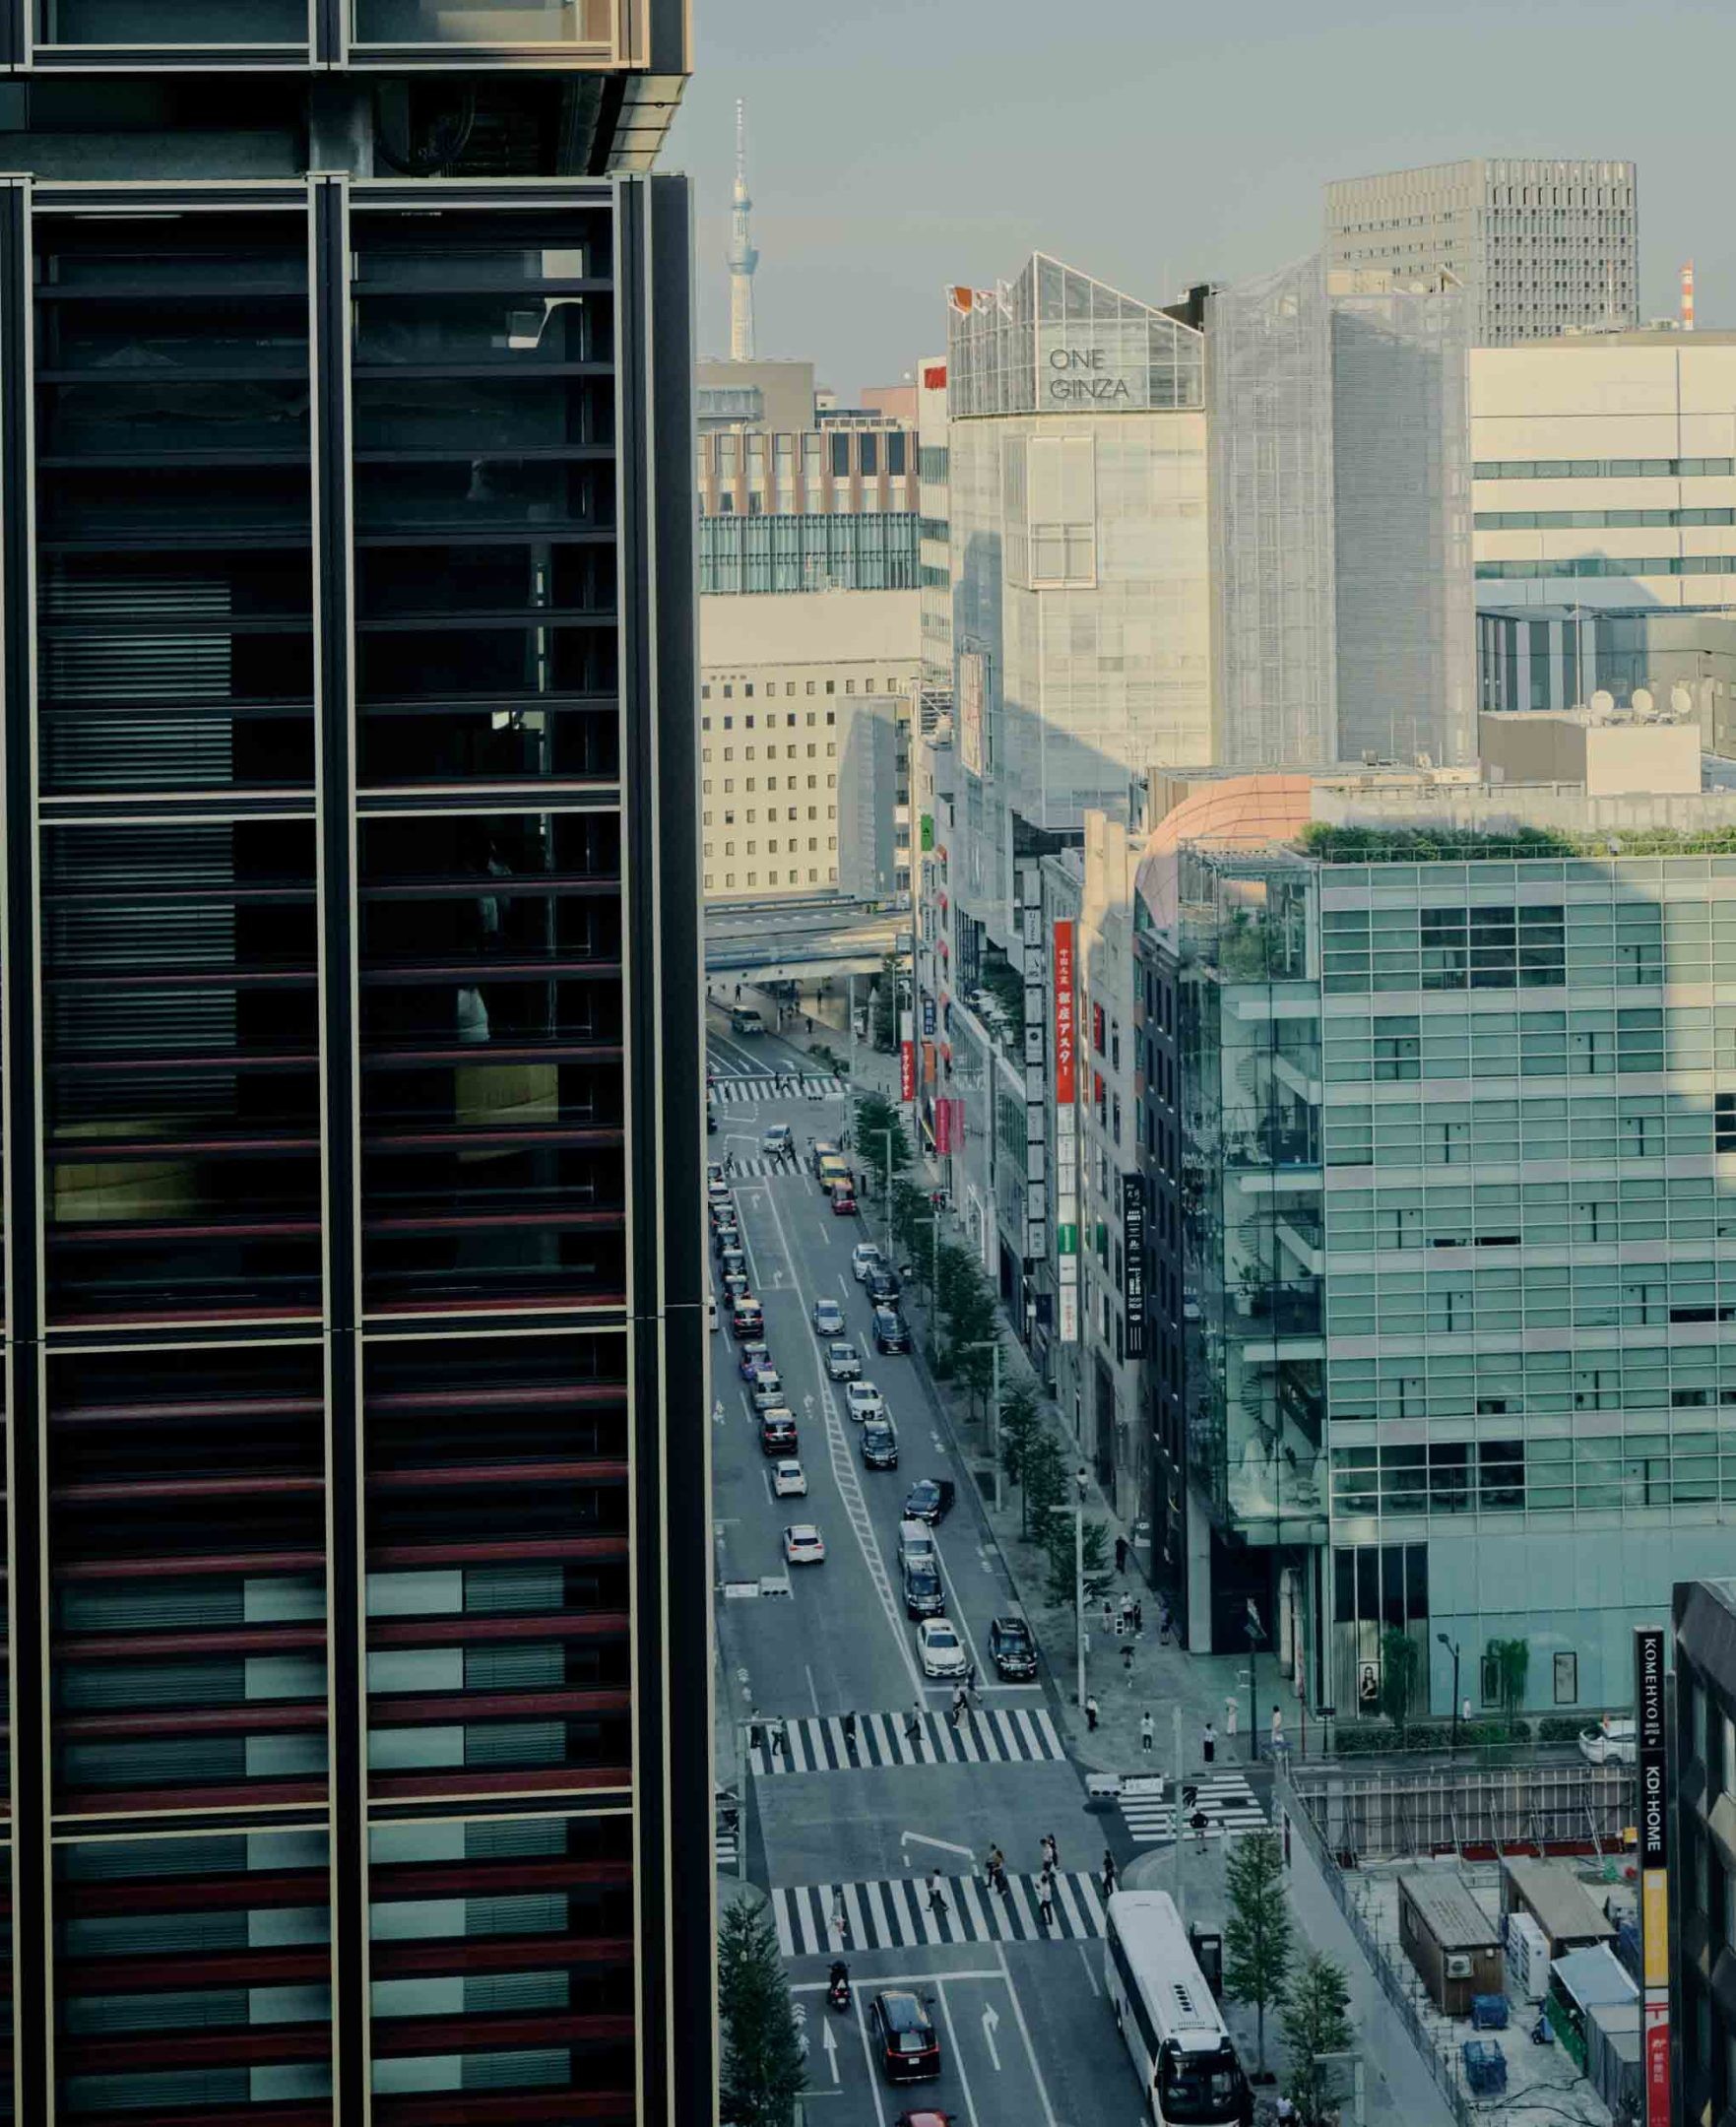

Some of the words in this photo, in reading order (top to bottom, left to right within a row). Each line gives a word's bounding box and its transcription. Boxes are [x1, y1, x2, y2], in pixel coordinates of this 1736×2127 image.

[1050, 349, 1104, 369] ONE
[1050, 378, 1129, 400] GINZA
[1644, 1639, 1658, 1719] KOMEHYO
[1646, 1766, 1661, 1851] KDI-HOME
